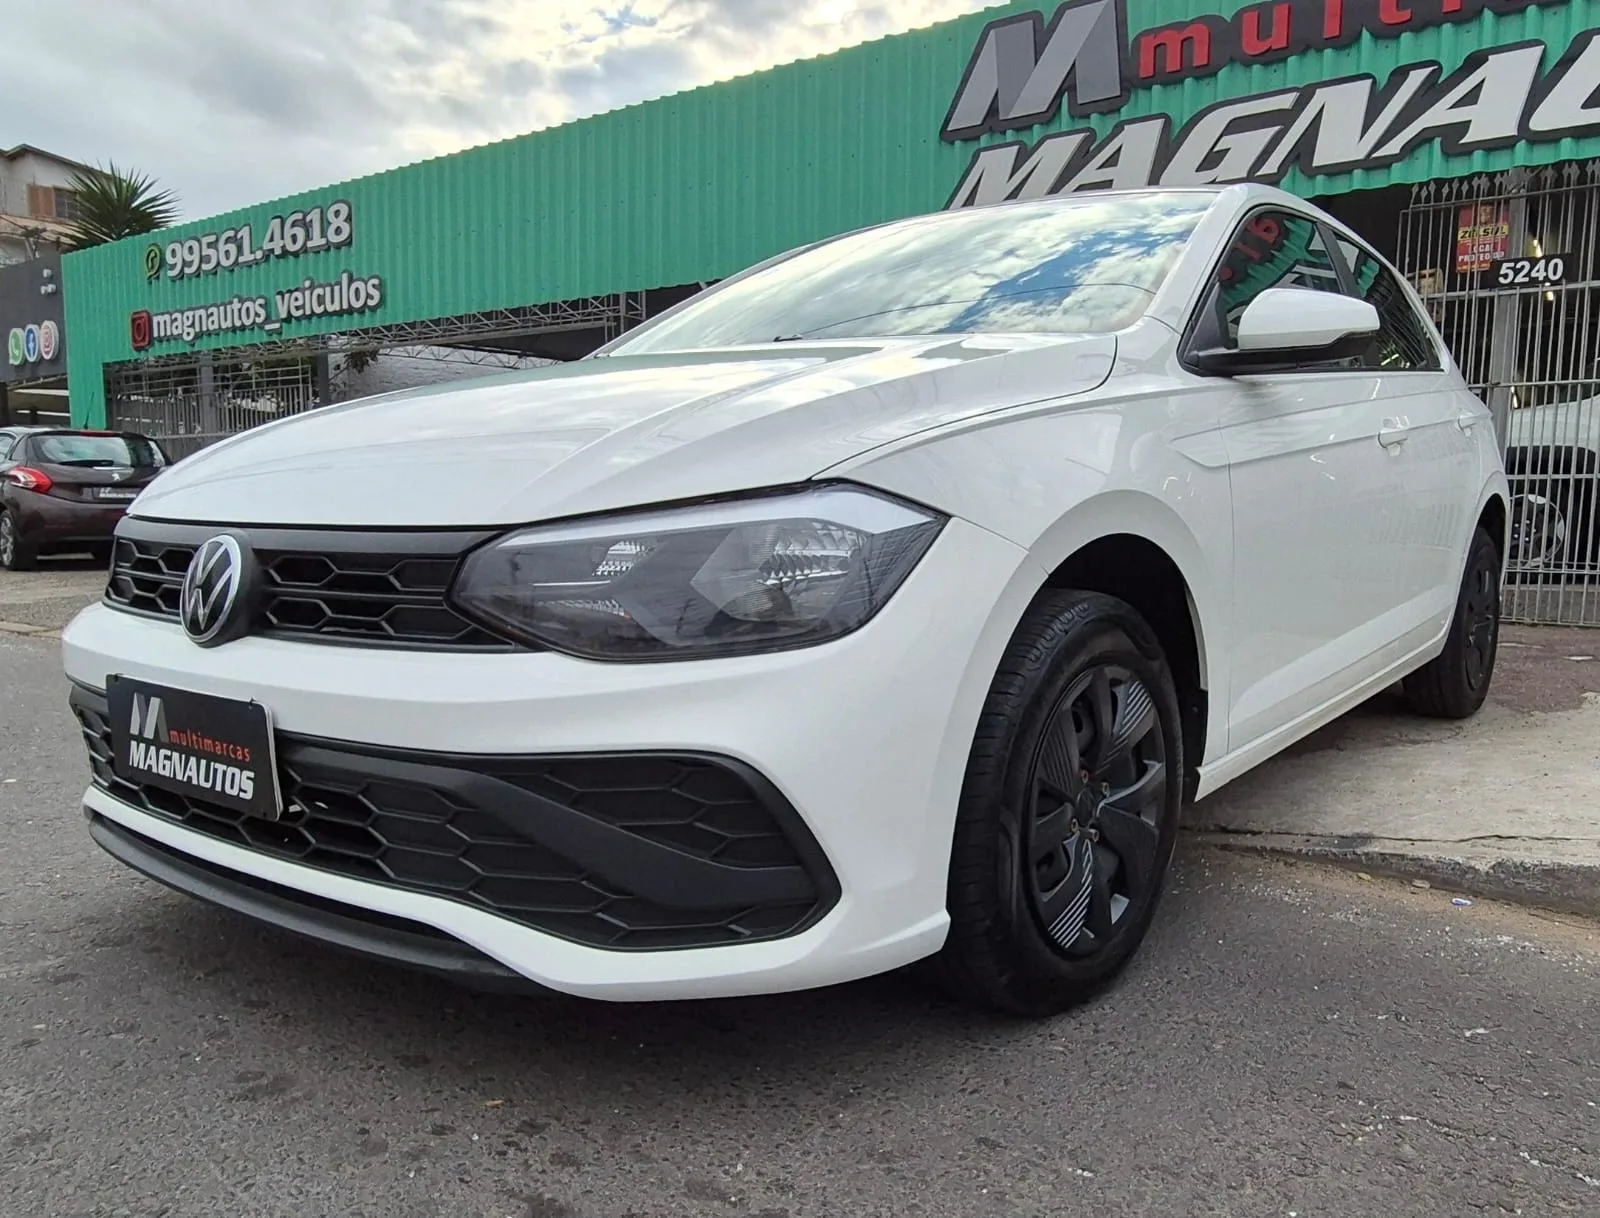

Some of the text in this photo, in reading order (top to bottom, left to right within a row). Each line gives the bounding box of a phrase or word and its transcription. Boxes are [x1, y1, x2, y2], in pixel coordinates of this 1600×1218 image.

[165, 202, 351, 278] 99561.4618
[1498, 258, 1564, 284] 5240
[152, 272, 381, 342] magnautos_veiculos
[128, 739, 256, 801] MAGNAUTOS
[168, 729, 252, 762] multimarcas
